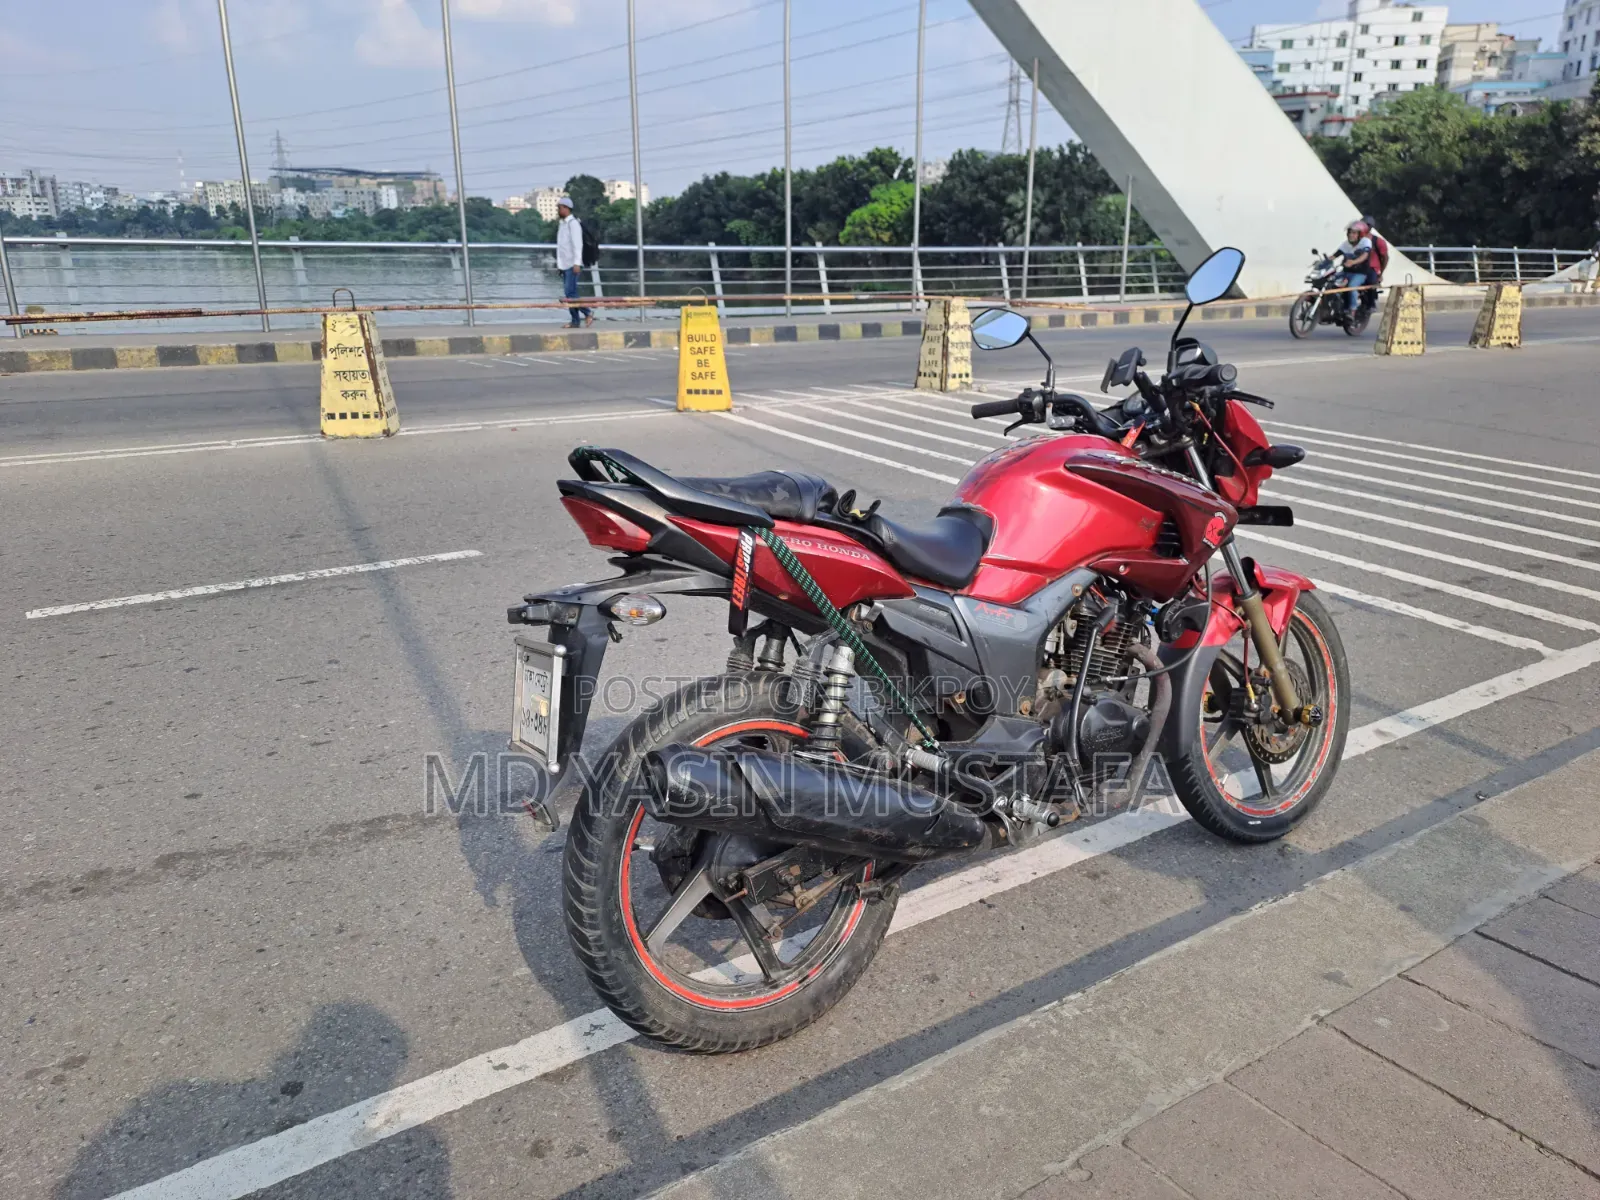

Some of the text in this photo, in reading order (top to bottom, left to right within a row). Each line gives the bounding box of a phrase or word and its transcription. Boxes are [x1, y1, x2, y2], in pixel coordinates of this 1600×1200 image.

[687, 334, 716, 343] BUILD
[690, 347, 716, 355] SAFE
[697, 359, 710, 368] BE
[334, 370, 371, 382] সহায়তা
[691, 371, 716, 380] SAFE
[341, 390, 367, 400] করুন
[779, 535, 871, 561] ERO HONDA
